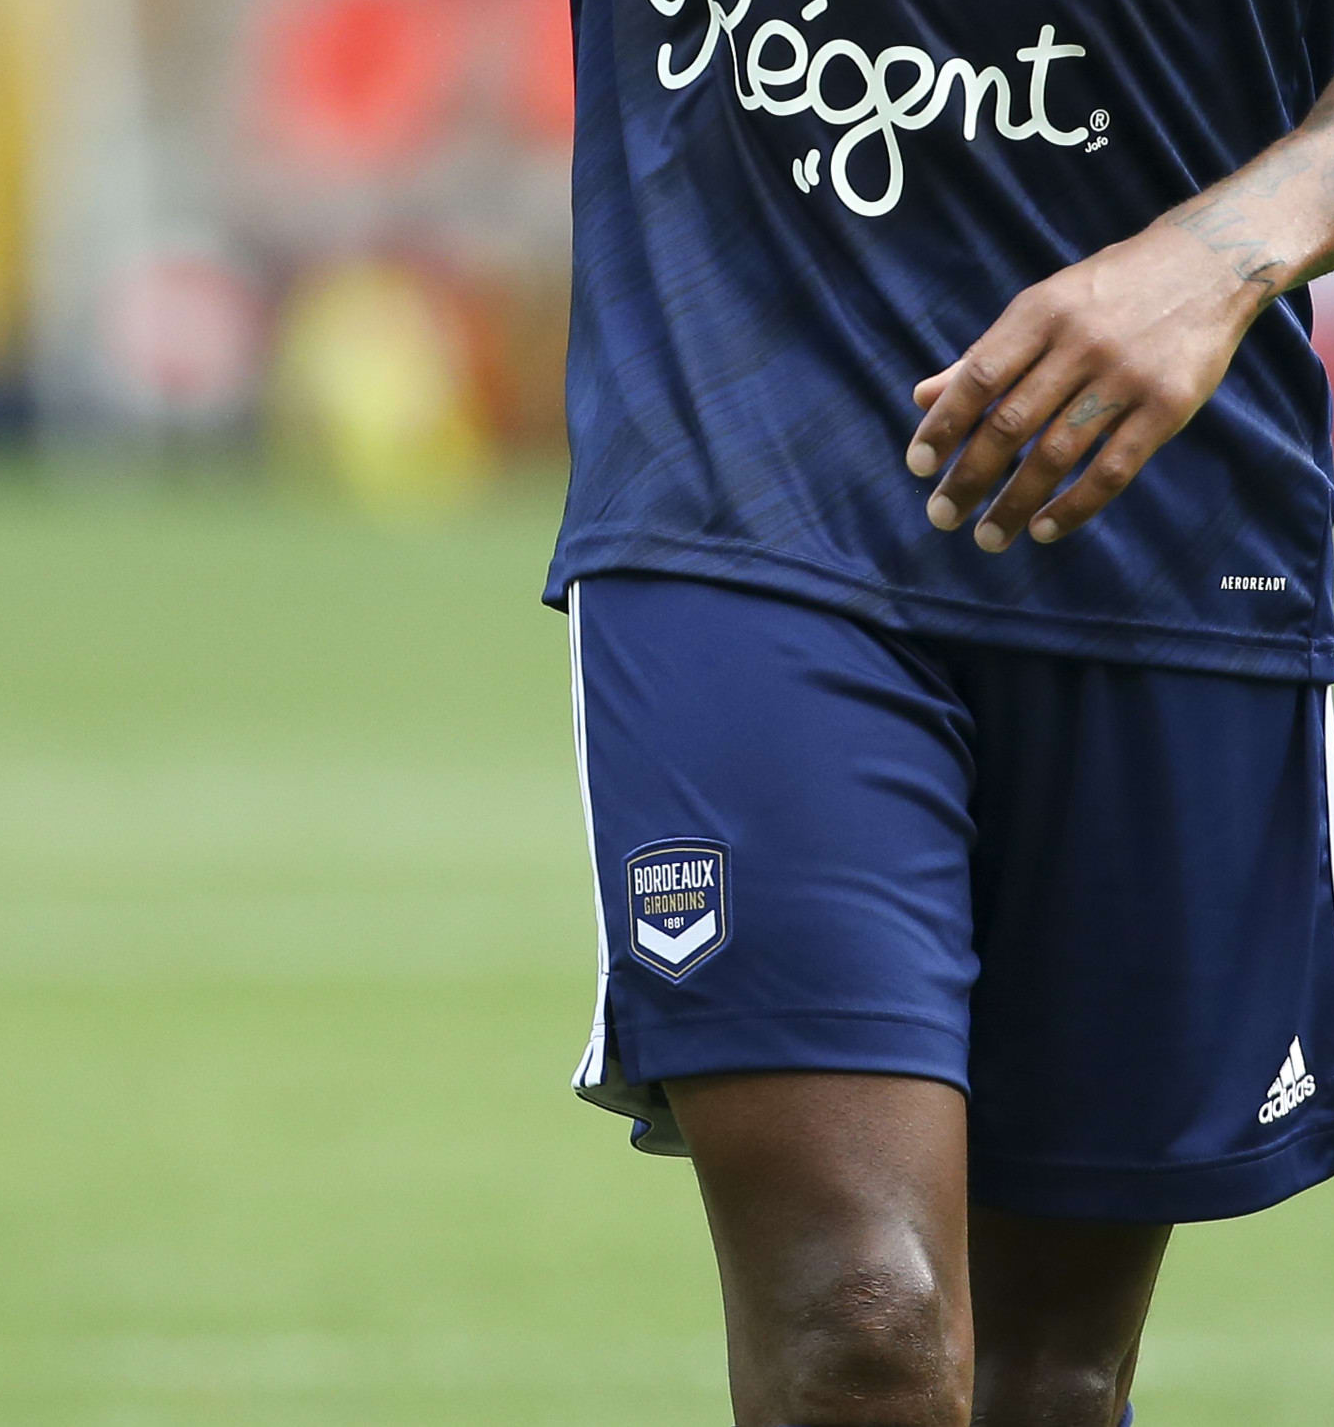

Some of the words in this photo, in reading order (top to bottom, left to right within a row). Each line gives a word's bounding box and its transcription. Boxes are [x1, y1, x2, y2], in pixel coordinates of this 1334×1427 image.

[1220, 575, 1287, 591] AEROREADY
[634, 859, 715, 895] BORDEAUX
[643, 890, 706, 916] GIRONDINS
[663, 916, 685, 930] 1881
[1258, 1074, 1316, 1124] adidas
